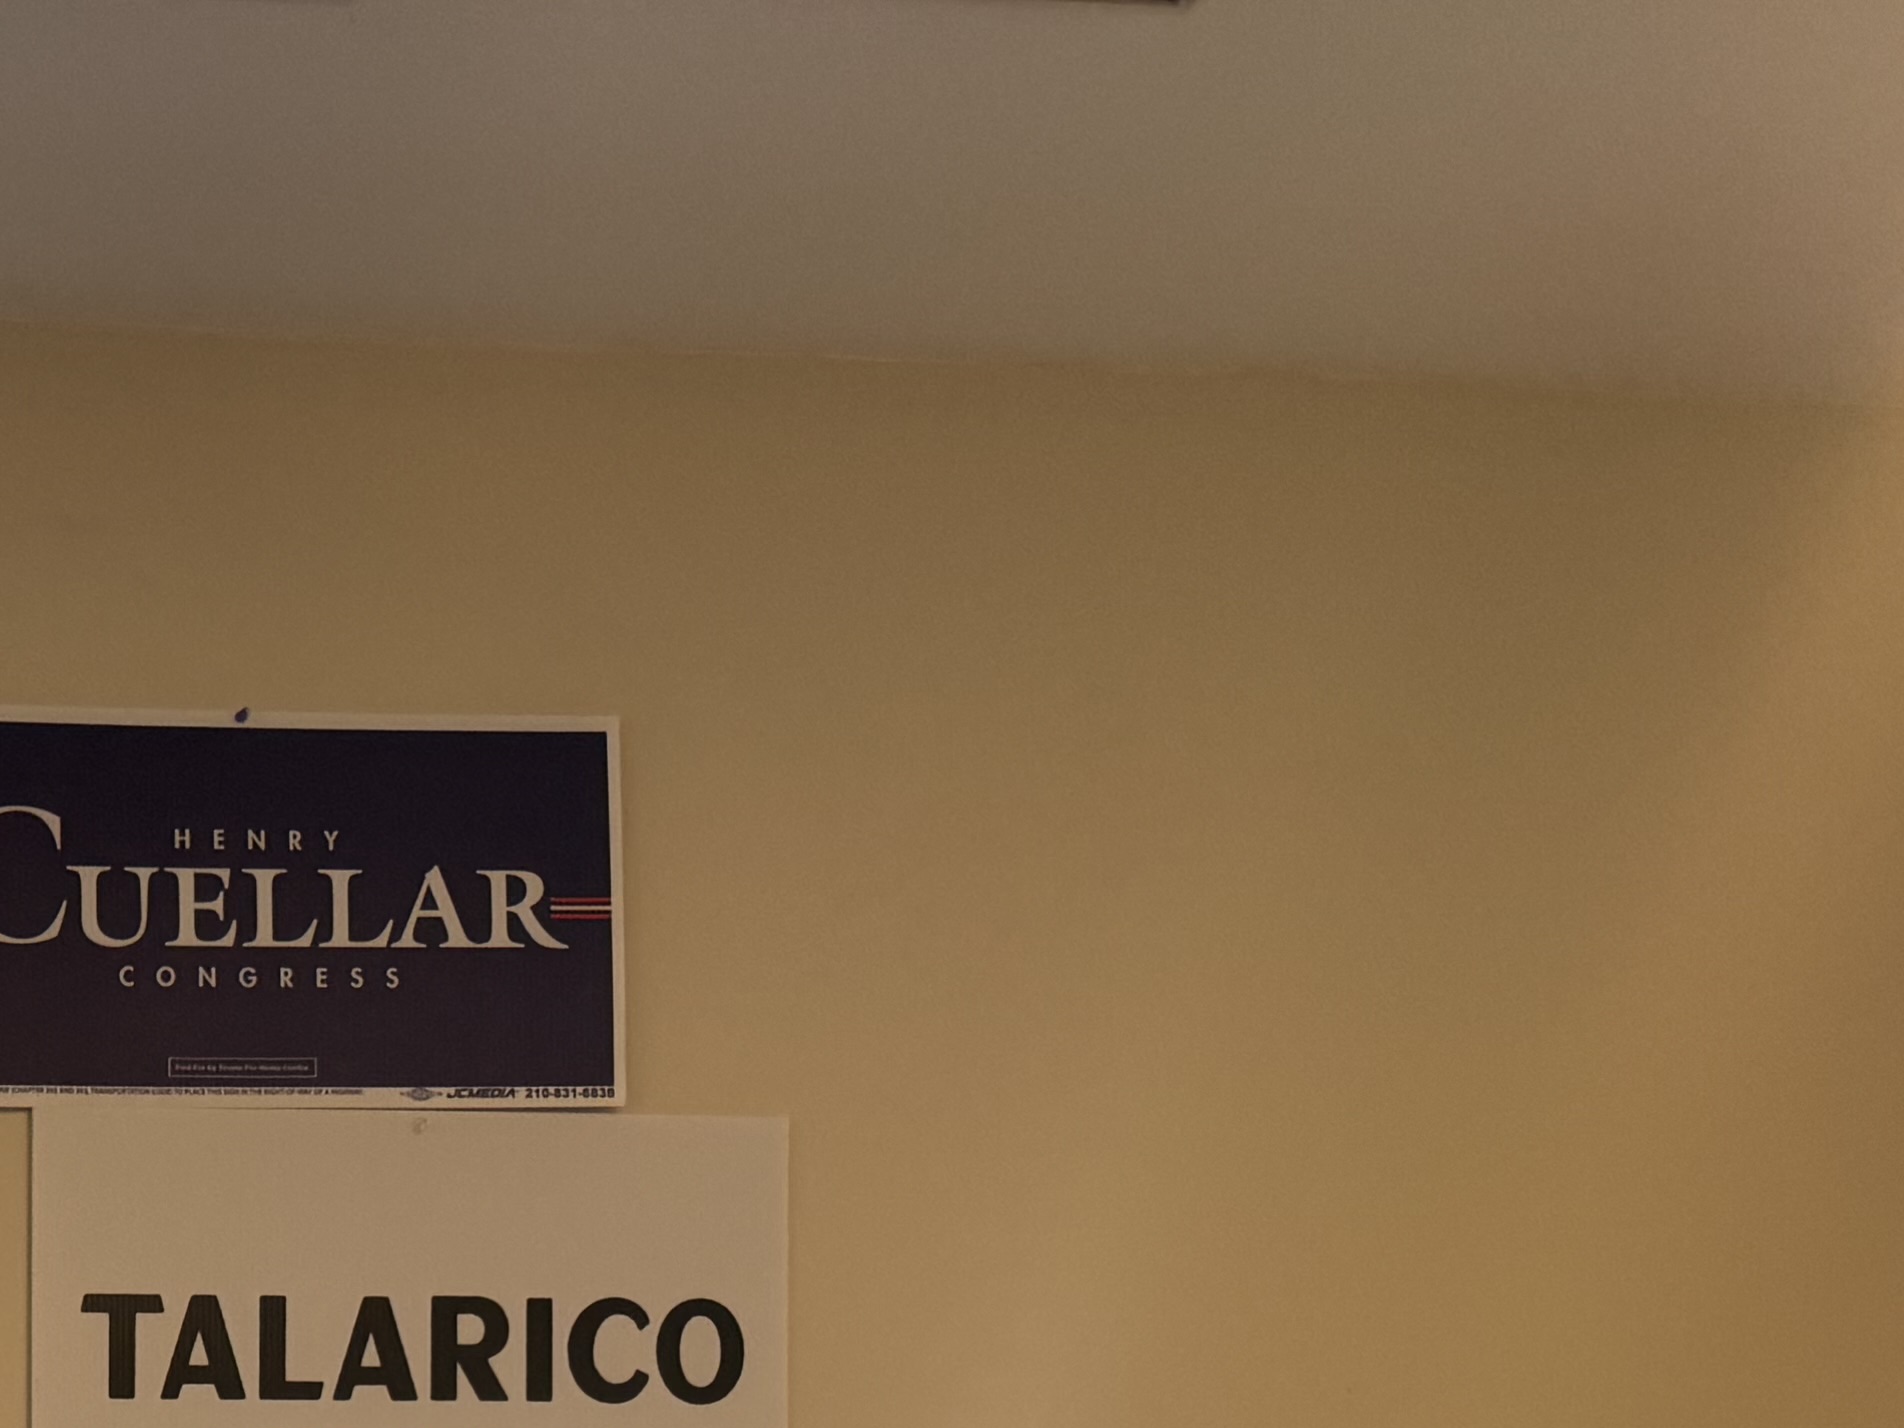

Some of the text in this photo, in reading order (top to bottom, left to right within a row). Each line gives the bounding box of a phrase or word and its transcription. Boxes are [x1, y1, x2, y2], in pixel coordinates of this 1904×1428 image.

[173, 828, 342, 852] HENRY
[118, 965, 403, 990] CONGRESS
[446, 1088, 517, 1099] JCMEDIA
[80, 1293, 746, 1405] TALARICO
